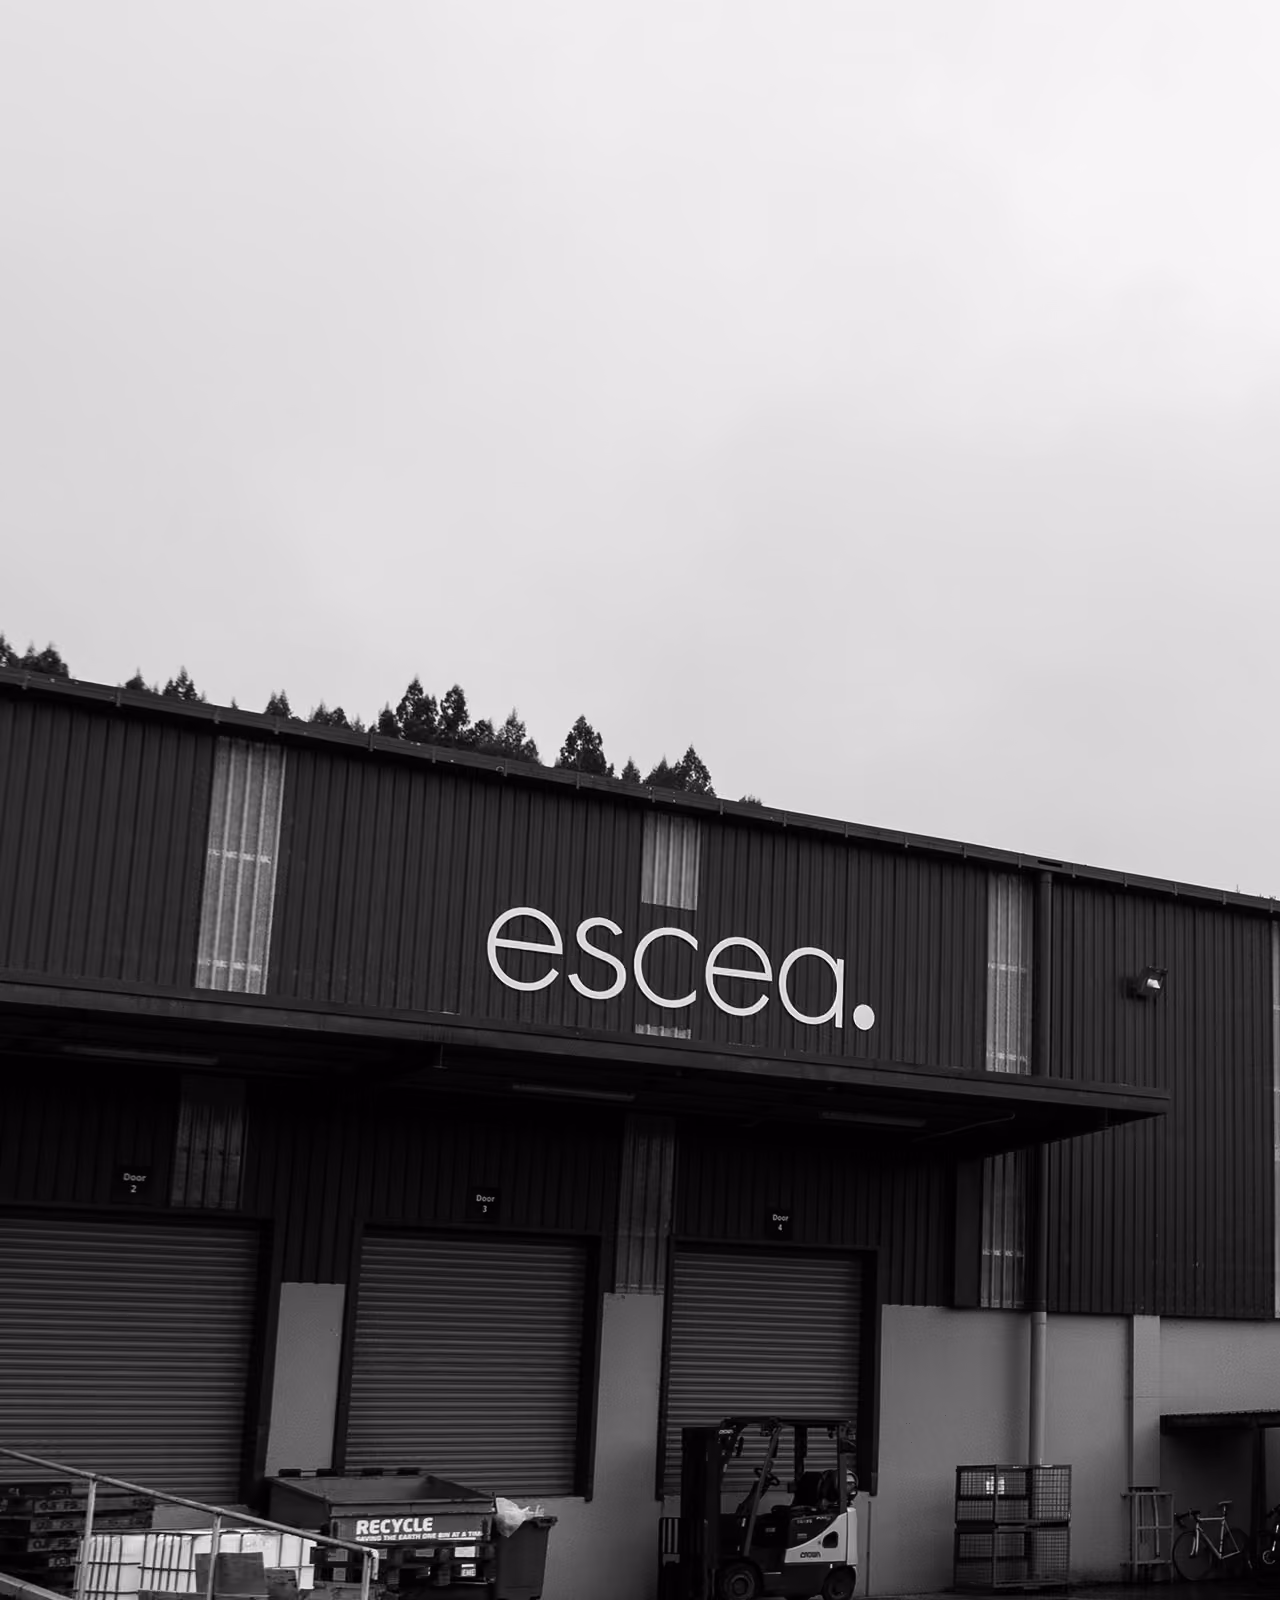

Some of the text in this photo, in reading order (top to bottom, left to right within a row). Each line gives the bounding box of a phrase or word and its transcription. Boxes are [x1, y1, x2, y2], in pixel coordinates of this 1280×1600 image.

[486, 906, 876, 1031] escea.
[123, 1172, 147, 1182] Door
[130, 1184, 137, 1194] 2
[475, 1194, 495, 1203] Door
[482, 1205, 488, 1213] 3
[772, 1213, 789, 1222] Door
[356, 1517, 434, 1535] RECYCLE
[421, 1532, 437, 1540] ONE
